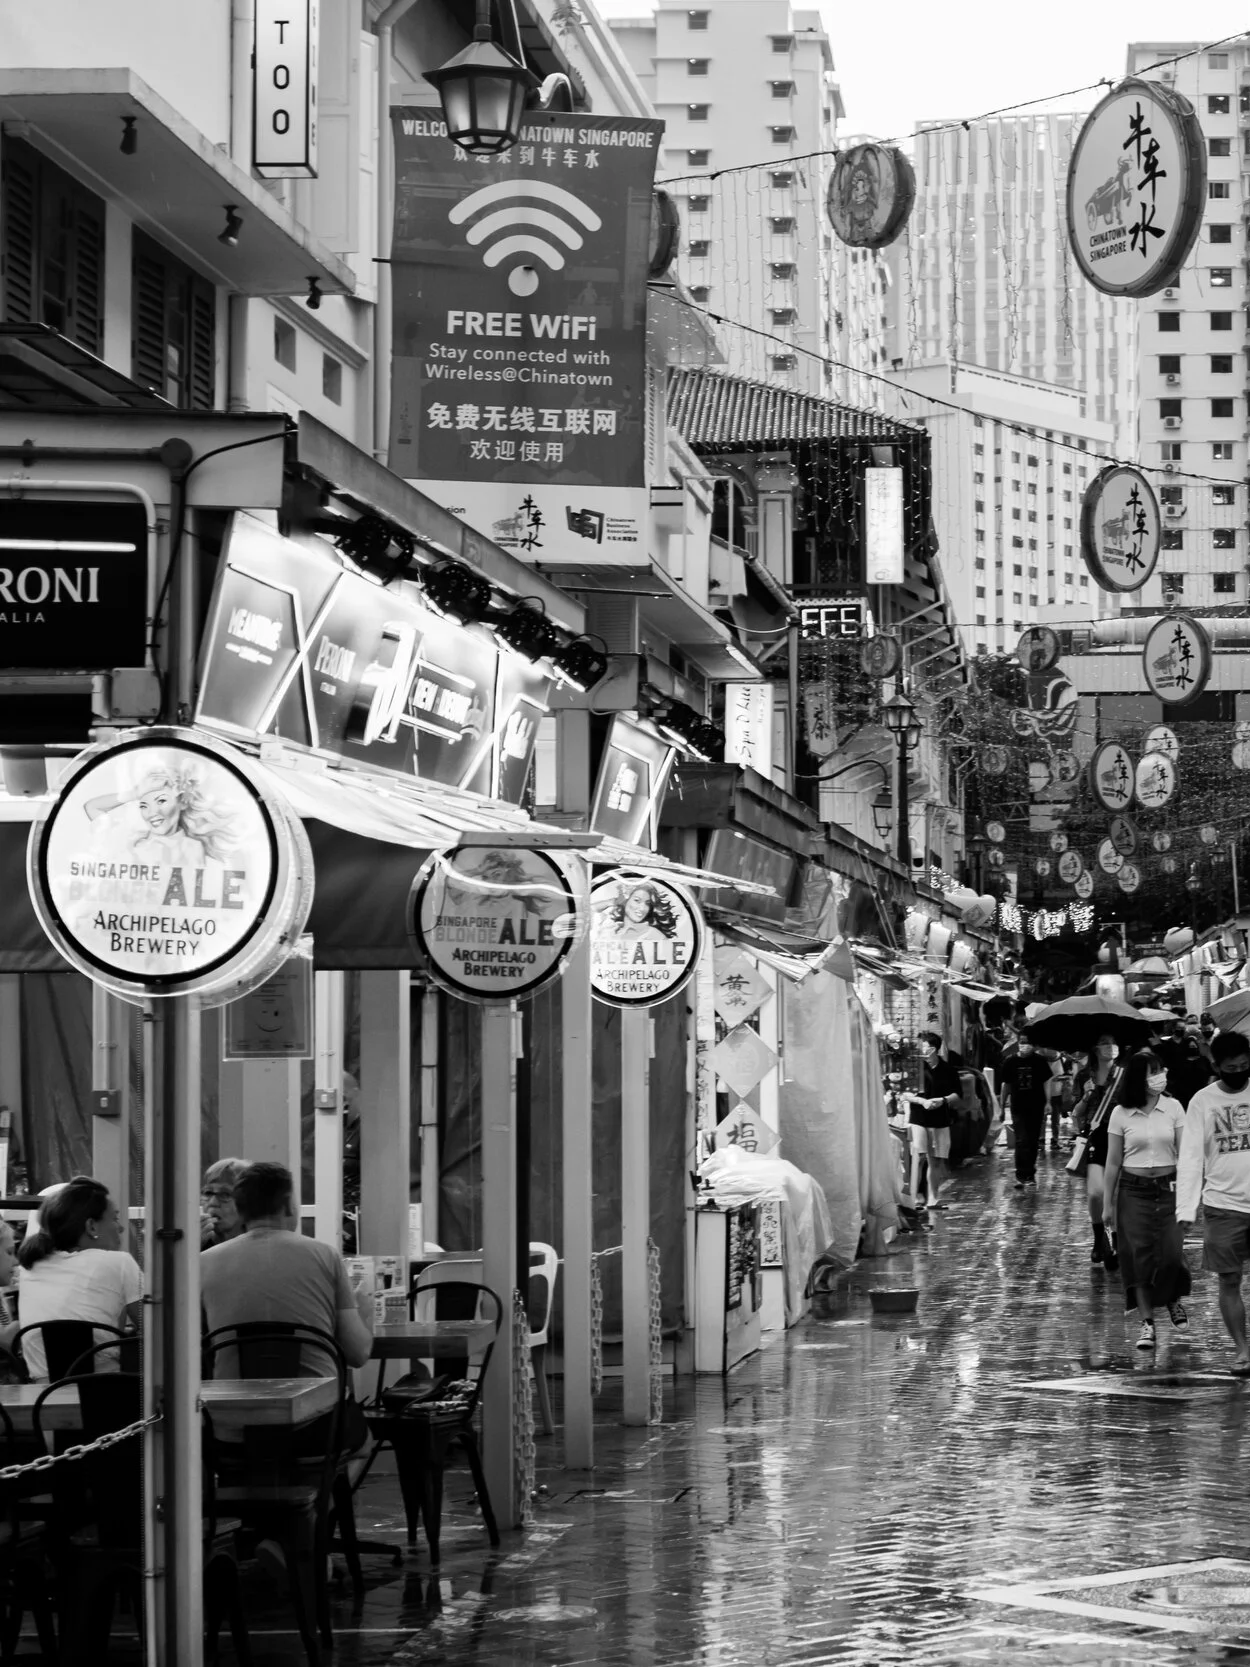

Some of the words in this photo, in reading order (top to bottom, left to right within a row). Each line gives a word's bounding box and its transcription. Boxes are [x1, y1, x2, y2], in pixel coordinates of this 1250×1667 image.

[402, 119, 447, 137] WELCO
[519, 125, 574, 144] NATOWN
[578, 128, 655, 148] SINGAPORE
[1090, 226, 1127, 247] CHINATOWN
[1090, 241, 1127, 263] SINGAPORE
[447, 310, 522, 337] FREE
[529, 313, 597, 340] WiFi
[429, 342, 468, 363] Stay
[473, 348, 567, 364] connected
[573, 350, 611, 365] with
[425, 363, 613, 386] Wireless@Chinatown
[427, 402, 617, 436] 免费无线互联网
[469, 438, 564, 463] 欢迎使用
[70, 861, 160, 882] SINGAPORE
[162, 866, 246, 910] ALE
[92, 910, 217, 936] ARCHIPELAGO
[436, 915, 497, 929] SINGAPORE
[498, 918, 554, 946] ALE
[110, 932, 200, 956] BREWERY
[435, 927, 499, 944] BLONDE
[452, 948, 536, 964] ARCHIPELAGO
[631, 941, 686, 965] ALE
[464, 961, 526, 977] BREWERY
[595, 968, 670, 981] ARCHIPELAGO
[607, 981, 661, 993] BREWERY
